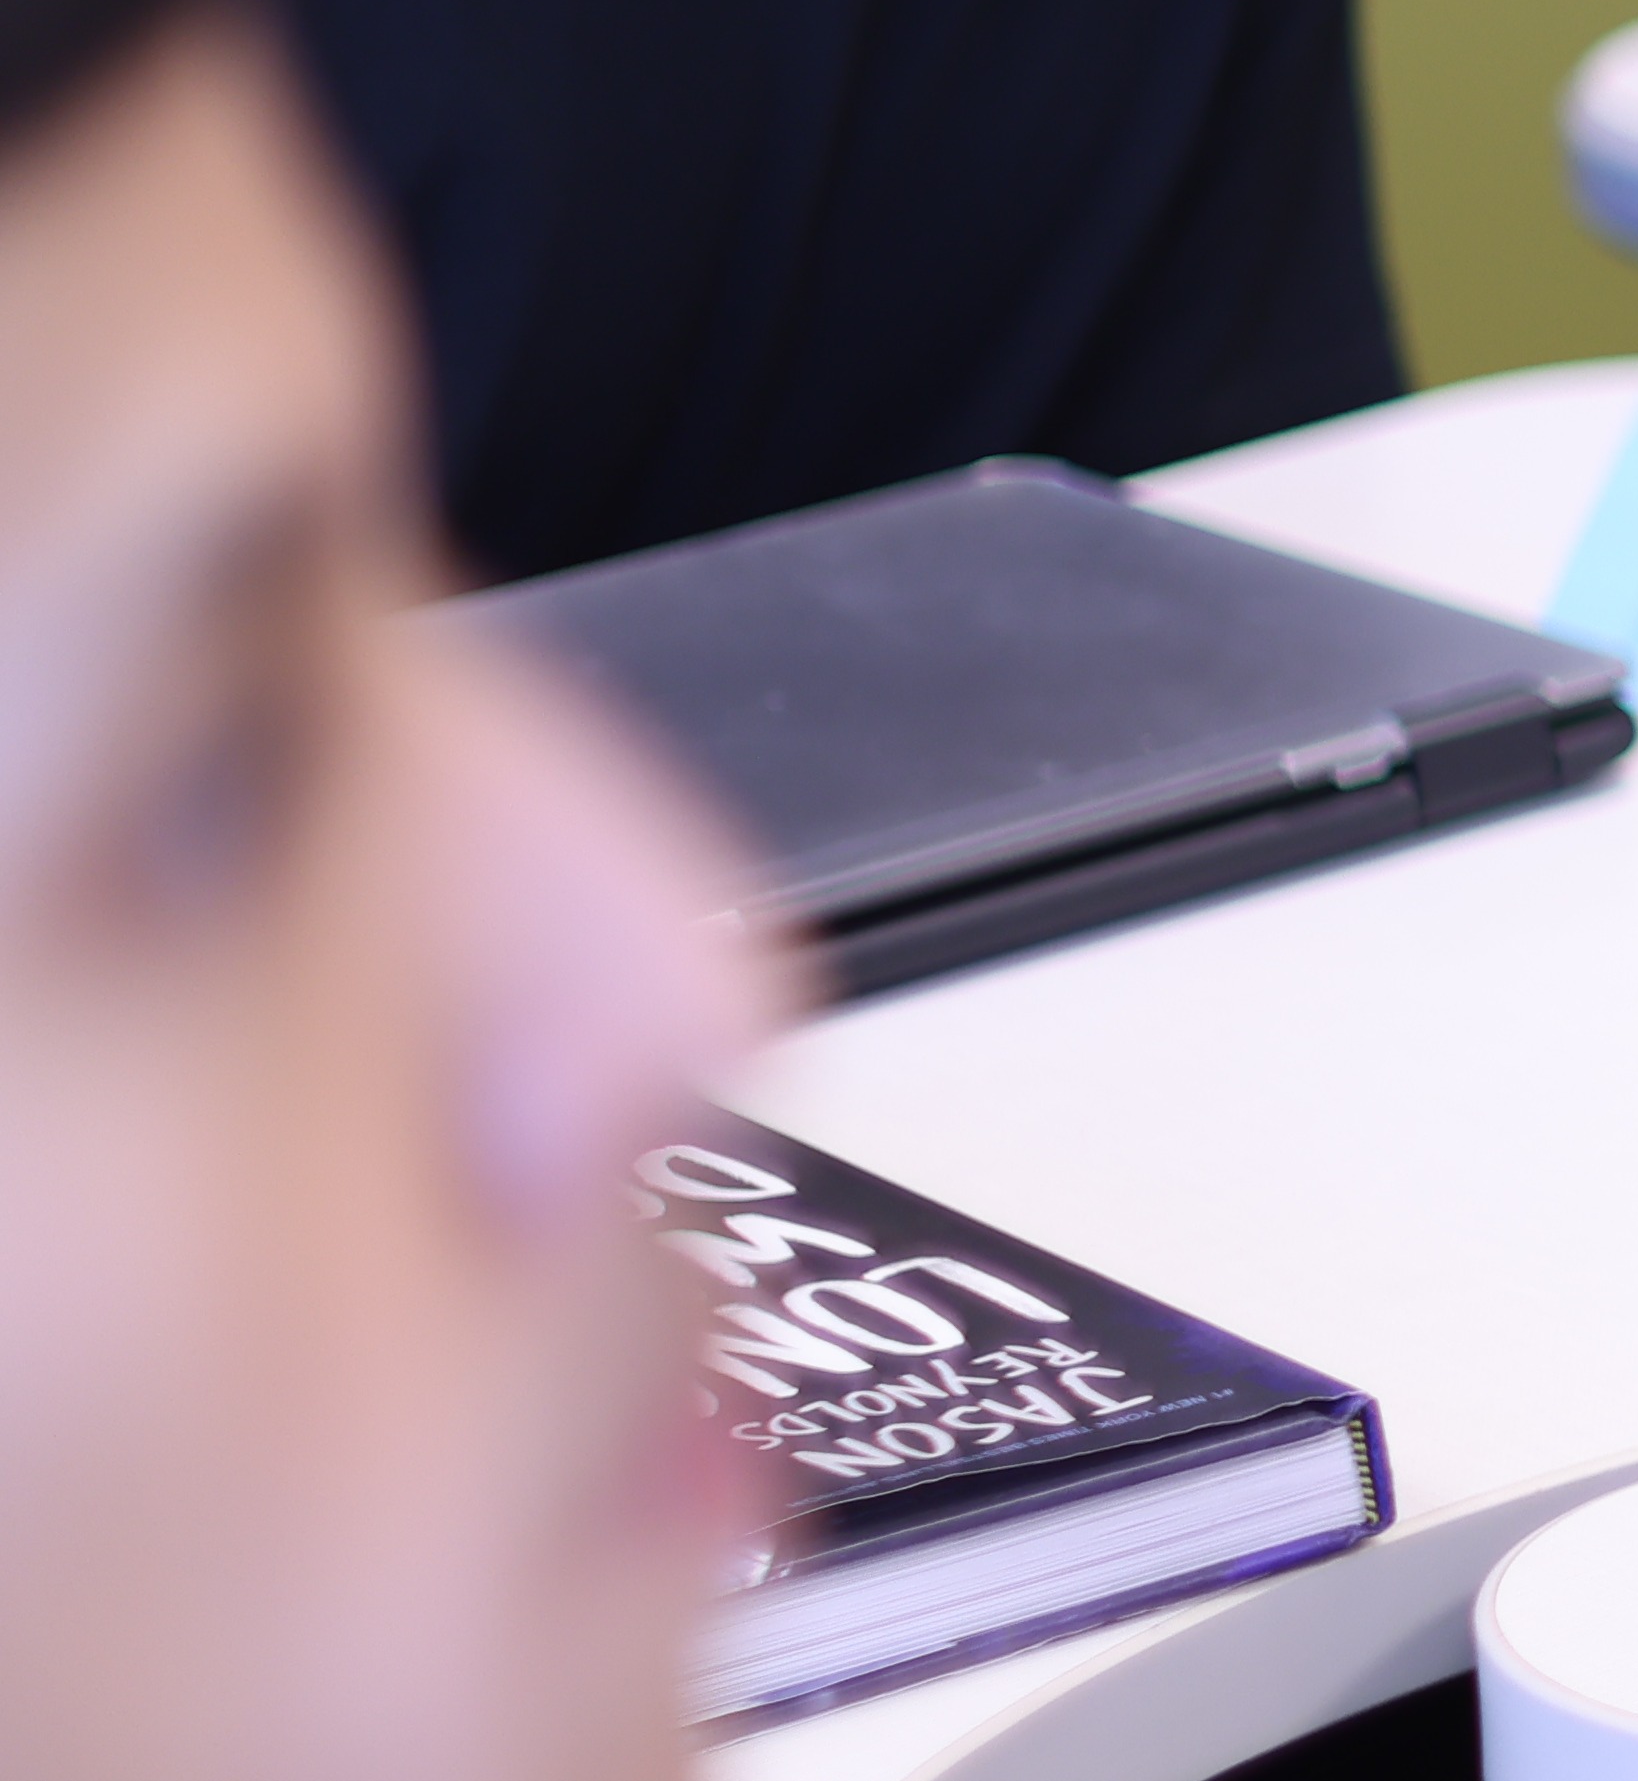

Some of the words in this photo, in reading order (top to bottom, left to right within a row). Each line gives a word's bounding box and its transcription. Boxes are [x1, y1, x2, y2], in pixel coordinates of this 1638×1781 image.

[696, 1256, 1071, 1418] LON
[730, 1338, 1099, 1450] REYNOLDS
[791, 1366, 1154, 1478] JASON
[1096, 1409, 1157, 1430] YORK
[1158, 1394, 1208, 1413] NEW
[1030, 1425, 1093, 1446] TIMES
